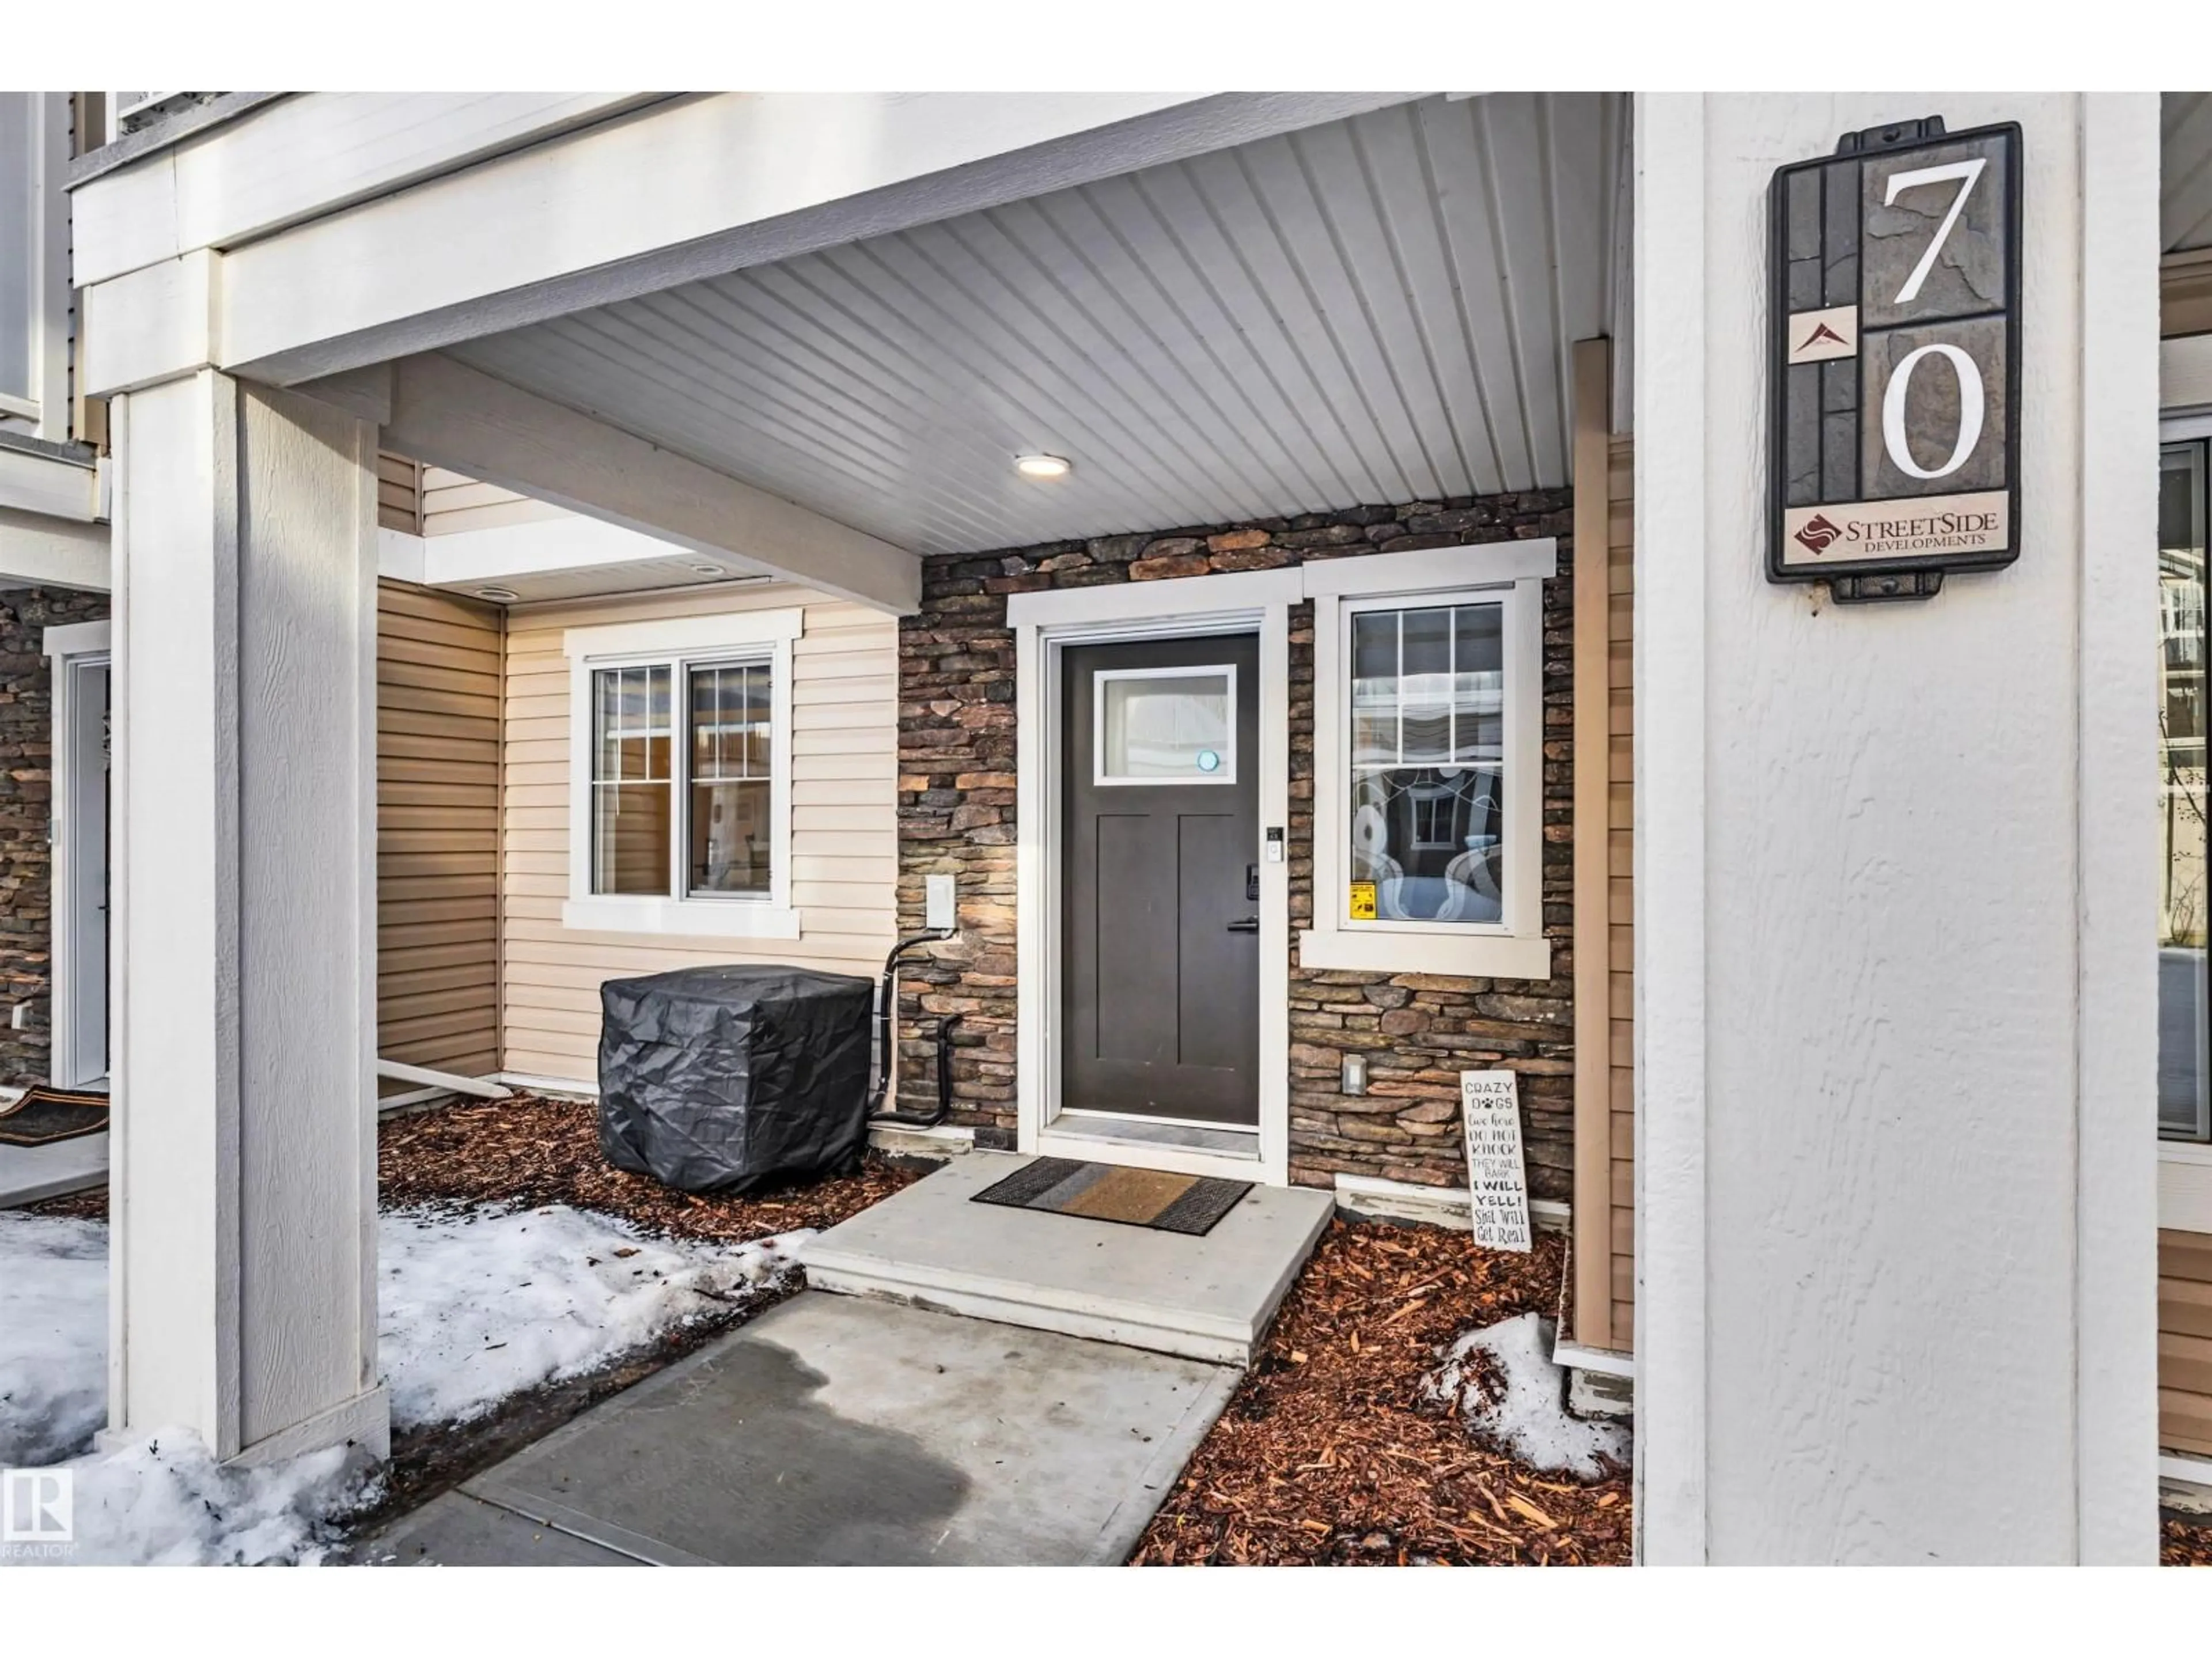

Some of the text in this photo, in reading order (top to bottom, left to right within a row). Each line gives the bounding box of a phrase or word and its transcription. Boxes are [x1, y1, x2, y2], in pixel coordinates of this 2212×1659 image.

[1884, 158, 1987, 304] 7
[1883, 343, 1985, 479] 0
[1865, 533, 1986, 553] DEVELOPMENTS
[1465, 1082, 1513, 1094] CRAZY
[1472, 1097, 1513, 1109] DGS
[1469, 1130, 1516, 1142] DO NOT
[1472, 1143, 1516, 1156] KNOCK
[1472, 1158, 1521, 1169] THEY WILL
[1484, 1168, 1510, 1179] BARK
[1474, 1180, 1523, 1191] I WILL
[1476, 1195, 1521, 1207] YELL!
[1499, 1209, 1525, 1225] Will
[1478, 1225, 1526, 1244] Get Real
